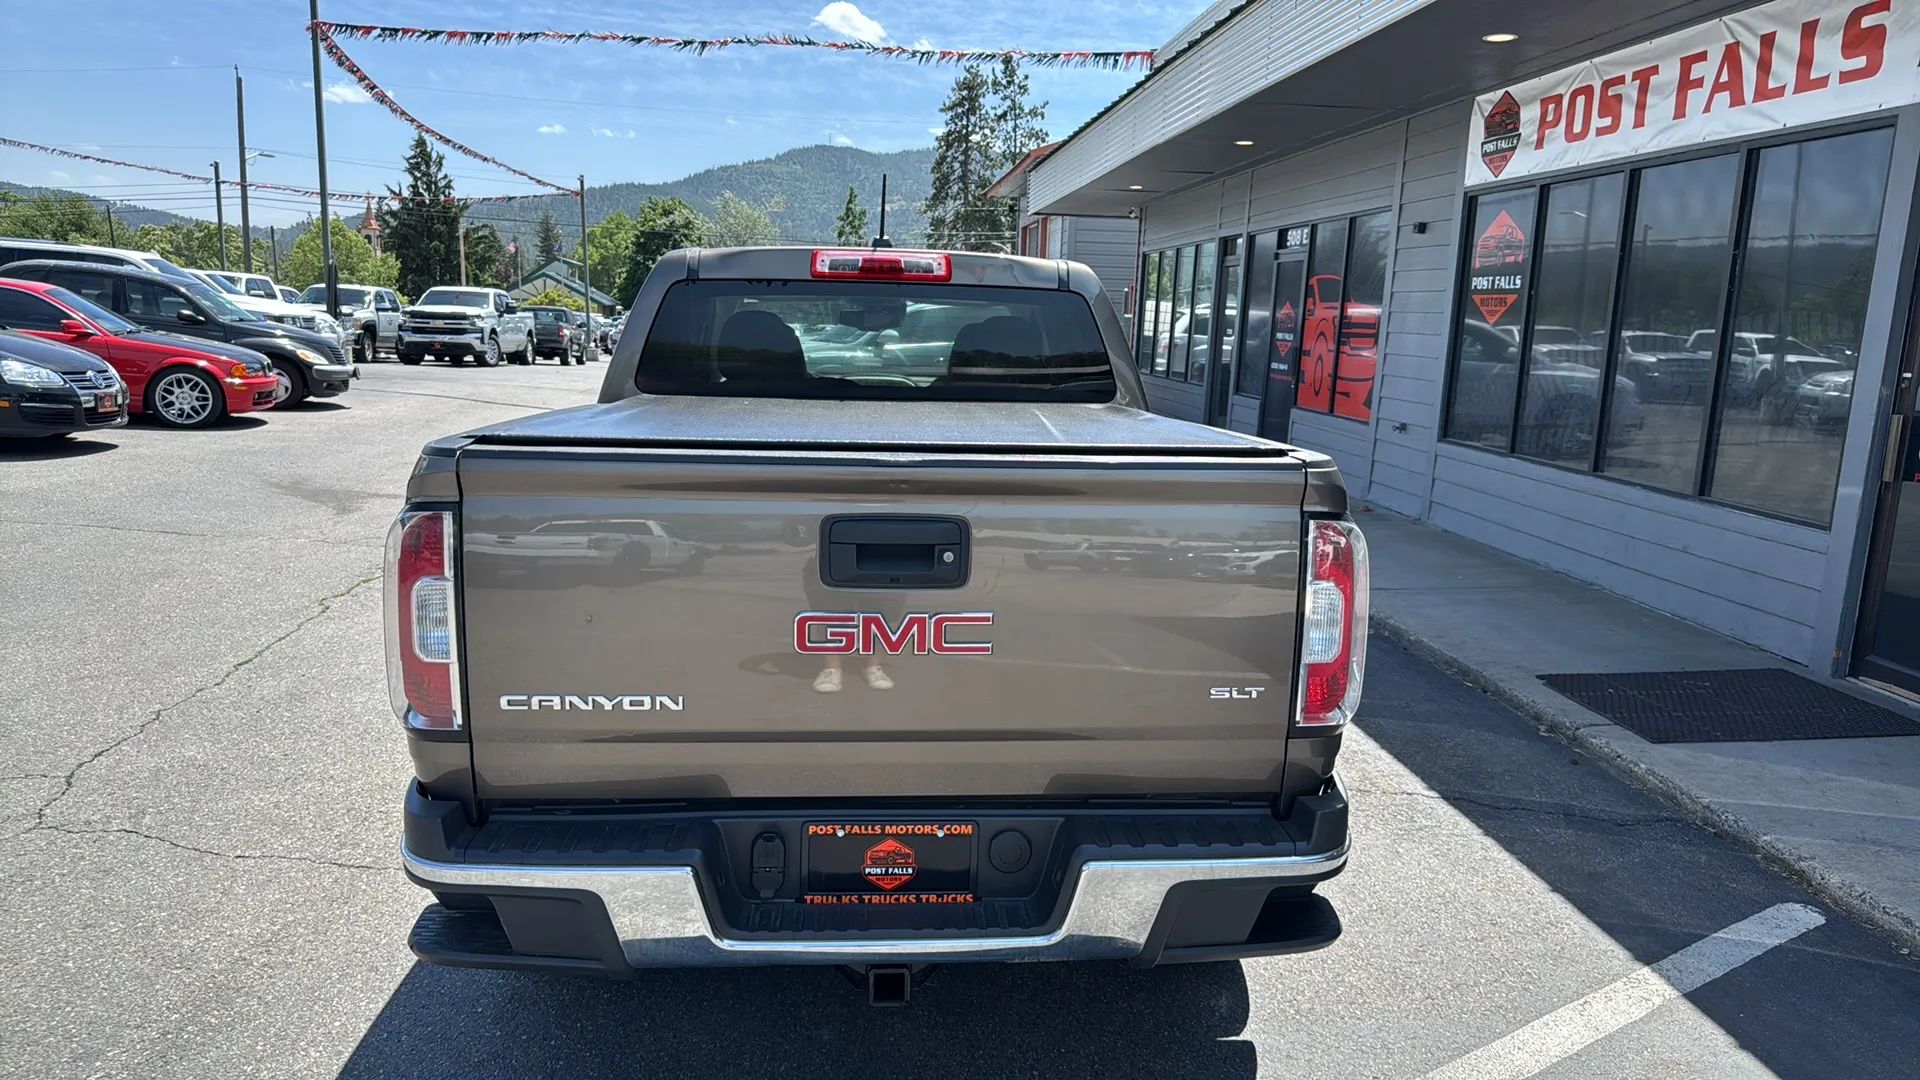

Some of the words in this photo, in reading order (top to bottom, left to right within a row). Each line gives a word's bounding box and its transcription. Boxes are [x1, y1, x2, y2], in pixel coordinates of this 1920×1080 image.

[1534, 64, 1660, 151] POST
[1672, 0, 1892, 121] FALLS
[1482, 141, 1497, 154] POST
[1497, 136, 1519, 150] FALLS
[1286, 229, 1302, 247] 508
[1471, 276, 1494, 290] POST
[1494, 275, 1522, 289] FALLS
[1480, 297, 1508, 307] MOTORS
[794, 611, 994, 656] GMC
[1209, 687, 1265, 699] SLT
[499, 694, 685, 711] CANYON
[808, 824, 842, 835] POST
[845, 824, 882, 835] FALLS
[884, 824, 973, 835] MOTORSCOM
[865, 867, 887, 875] POST
[888, 867, 913, 875] FALLS
[862, 895, 917, 905] TRUCKS
